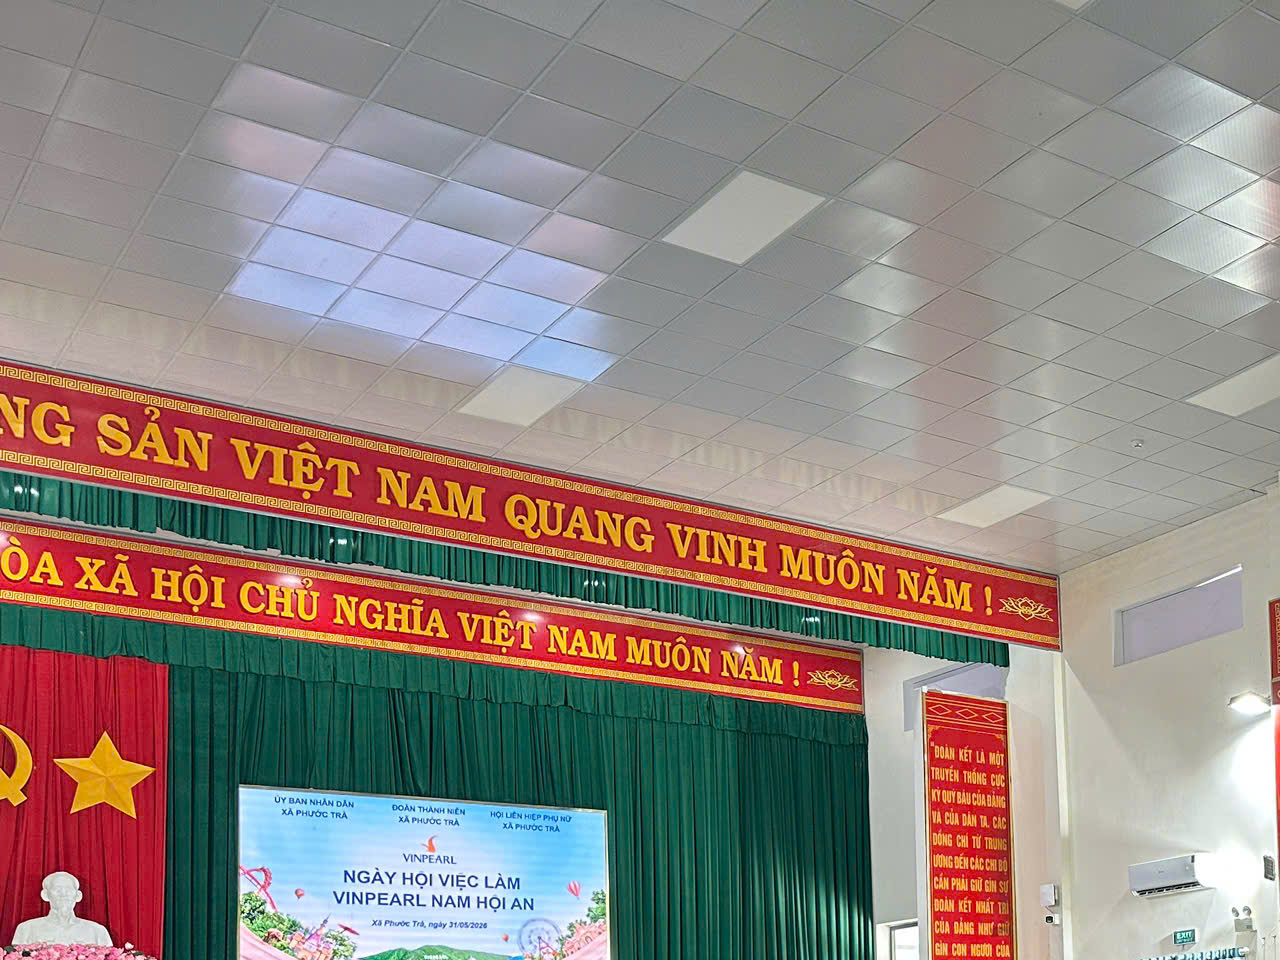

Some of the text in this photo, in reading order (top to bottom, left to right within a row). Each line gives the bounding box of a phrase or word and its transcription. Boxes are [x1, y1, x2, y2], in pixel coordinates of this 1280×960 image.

[96, 406, 211, 471] SẢN
[230, 438, 360, 501] VIỆT
[376, 468, 486, 524] NAM
[504, 494, 655, 555] QUANG
[666, 521, 768, 573] VINH
[779, 547, 886, 597] MUÔN
[897, 566, 972, 613] NĂM
[983, 585, 993, 616] !
[0, 536, 801, 686] ÒA XÃ HỘI CHỦ NGHĨA VIỆT NAM MUÔN NĂM !
[289, 797, 307, 805] BAN
[309, 797, 334, 807] NHÂN
[392, 804, 416, 812] ĐOÀN
[296, 809, 328, 818] PHƯỚC
[490, 811, 503, 819] HỘI
[412, 816, 442, 825] PHƯỚC
[515, 823, 543, 832] PHƯỚC
[402, 853, 457, 865] VINPEARL
[343, 867, 520, 891] NGÀY HỘI VIỆC LÀM
[333, 891, 534, 913] VINPEARL NAM HỘI AN
[1176, 930, 1192, 940] EXIT
[952, 943, 967, 956] CON
